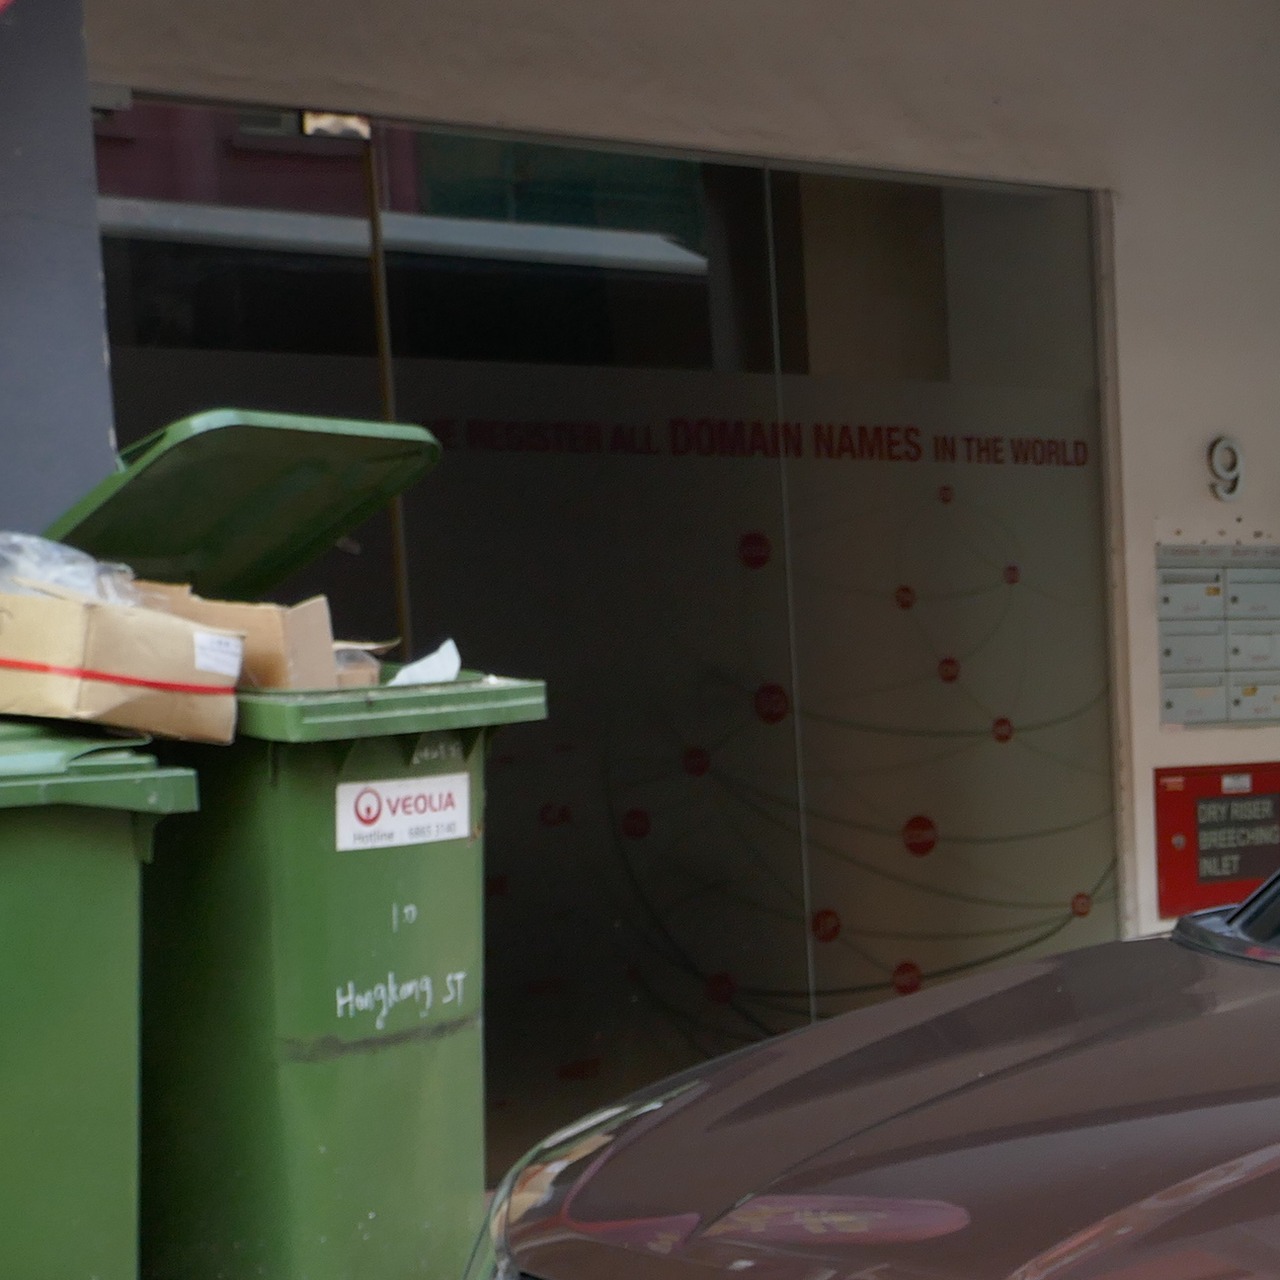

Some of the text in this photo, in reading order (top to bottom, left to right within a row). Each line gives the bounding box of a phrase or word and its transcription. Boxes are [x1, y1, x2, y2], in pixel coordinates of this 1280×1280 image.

[466, 418, 603, 454] REGISTER
[608, 423, 659, 455] ALL
[668, 417, 803, 458] DOMAIN
[813, 422, 922, 463] NAMES
[932, 435, 957, 463] IN
[962, 436, 1006, 466] THE
[1010, 438, 1089, 467] WORLD
[1205, 435, 1245, 502] 9
[386, 791, 456, 816] VEOLIA
[1198, 799, 1272, 823] DRY RISER
[1199, 825, 1280, 850] BREECHING
[1199, 854, 1240, 877] INLET
